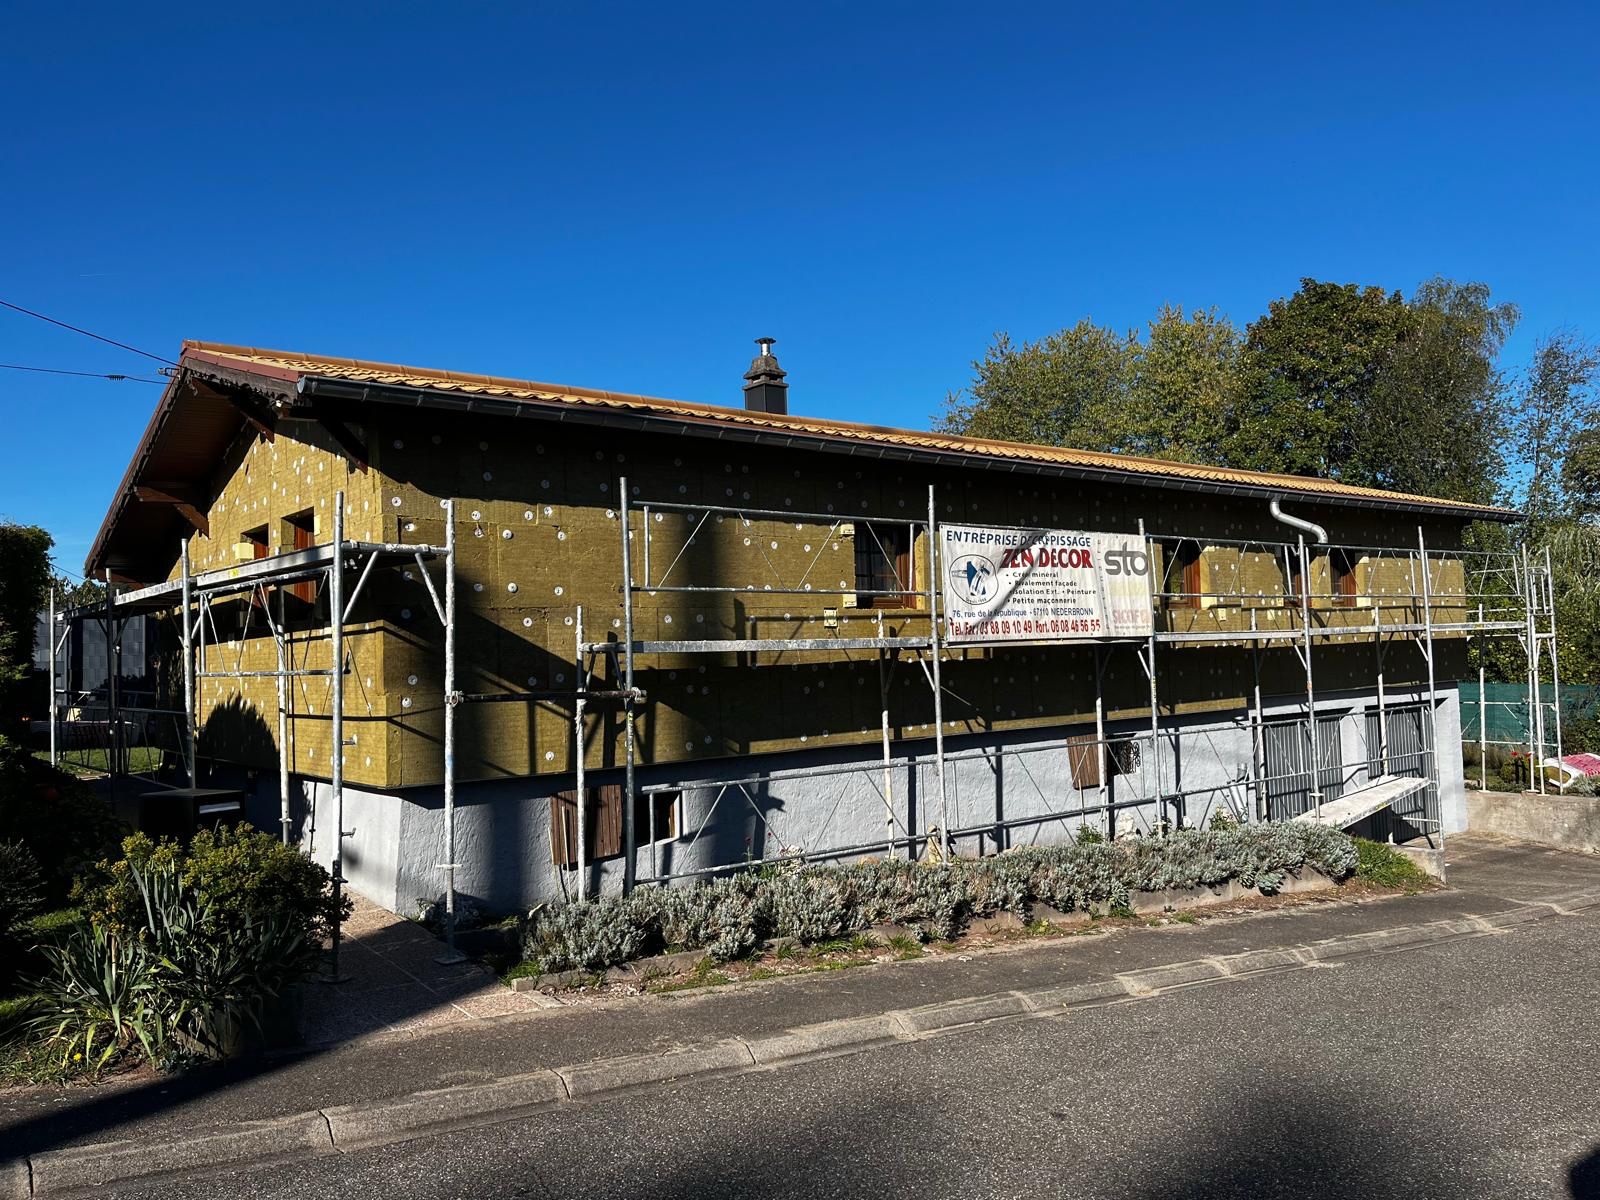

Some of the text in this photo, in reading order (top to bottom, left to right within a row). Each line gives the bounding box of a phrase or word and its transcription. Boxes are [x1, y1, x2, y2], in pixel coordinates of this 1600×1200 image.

[1000, 548, 1034, 568] ZEN
[1104, 541, 1148, 576] sto
[1055, 580, 1077, 589] façade
[1036, 597, 1077, 606] maçonnerie
[978, 609, 987, 618] de
[1050, 607, 1094, 616] NIEDERBRONN
[979, 620, 989, 635] 03
[990, 620, 1000, 635] 88
[1001, 620, 1010, 634] 09
[1012, 620, 1022, 633] 10
[1023, 620, 1033, 633] 49
[1050, 620, 1060, 632] 06
[1060, 620, 1069, 632] 08
[1070, 619, 1080, 632] 46
[1080, 619, 1089, 632] 56
[1090, 619, 1101, 632] 55
